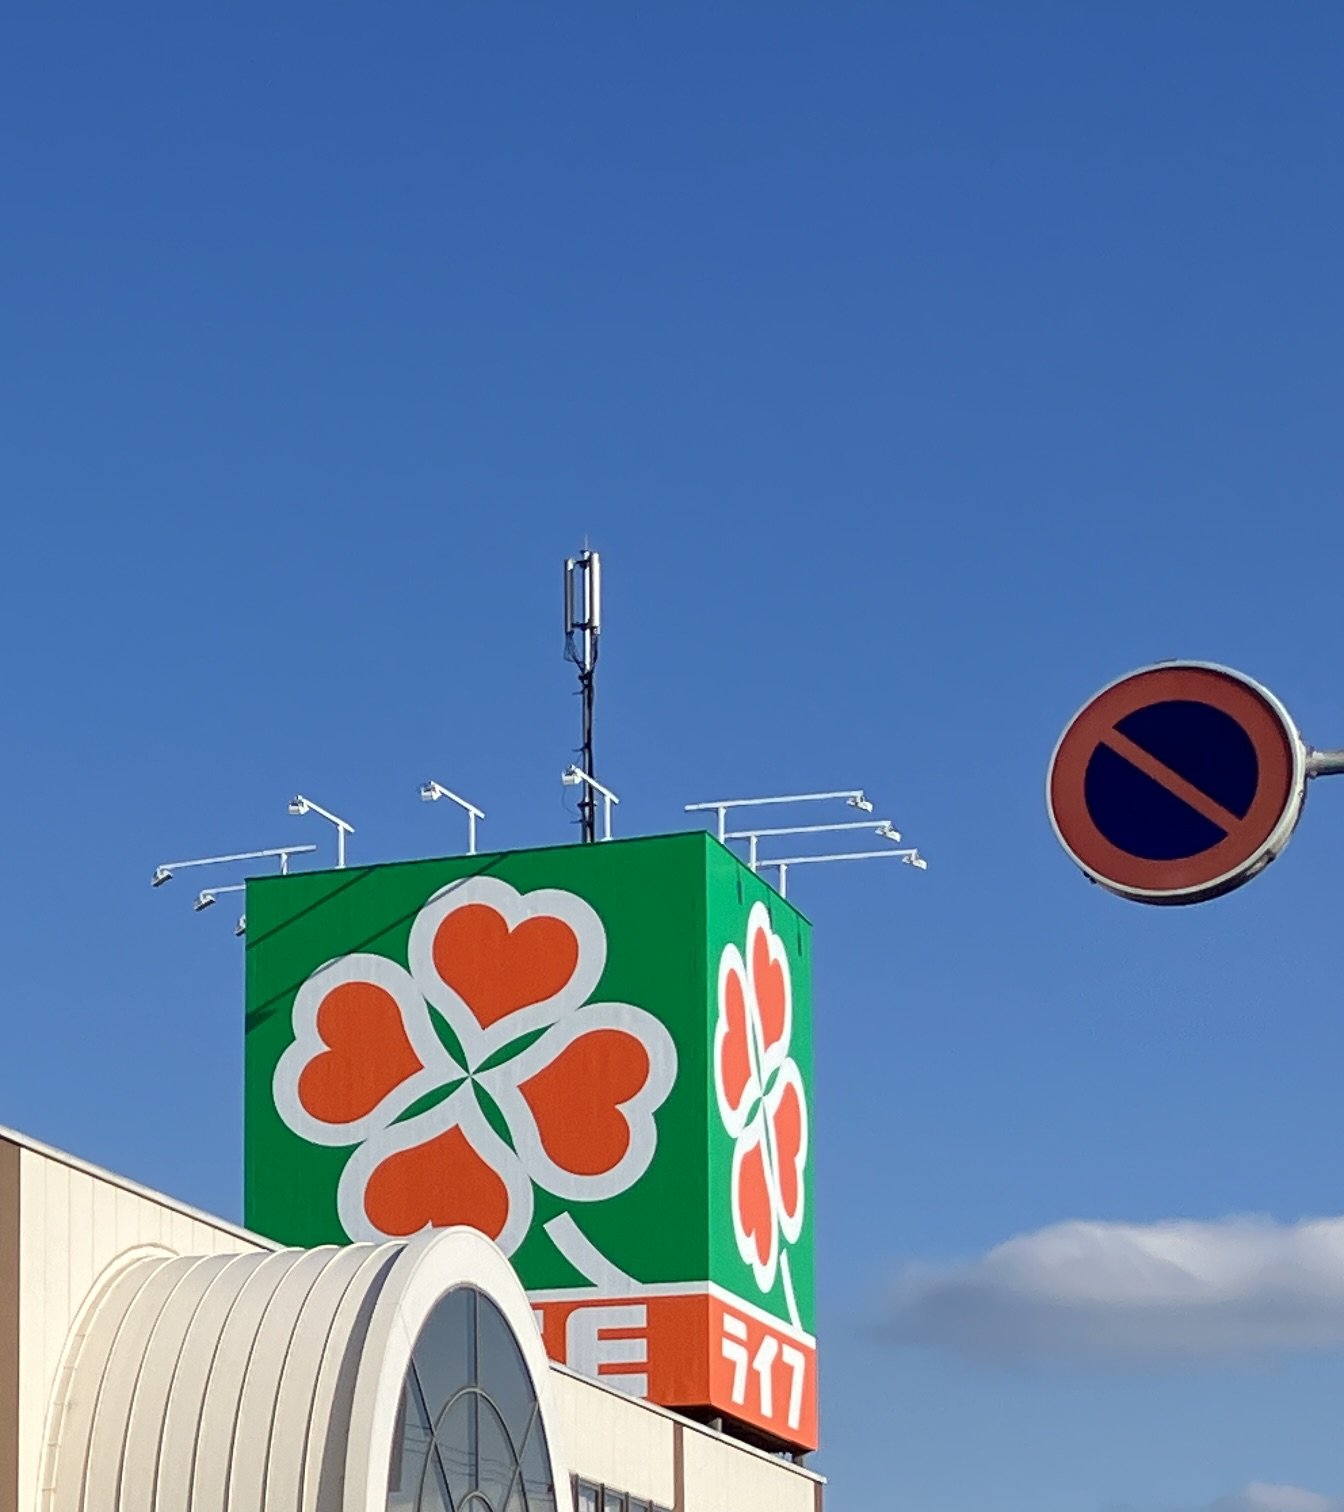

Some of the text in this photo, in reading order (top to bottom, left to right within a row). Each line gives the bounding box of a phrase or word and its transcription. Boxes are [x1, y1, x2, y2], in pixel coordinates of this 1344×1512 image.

[533, 1303, 648, 1399] E
[721, 1311, 806, 1430] ライフ
